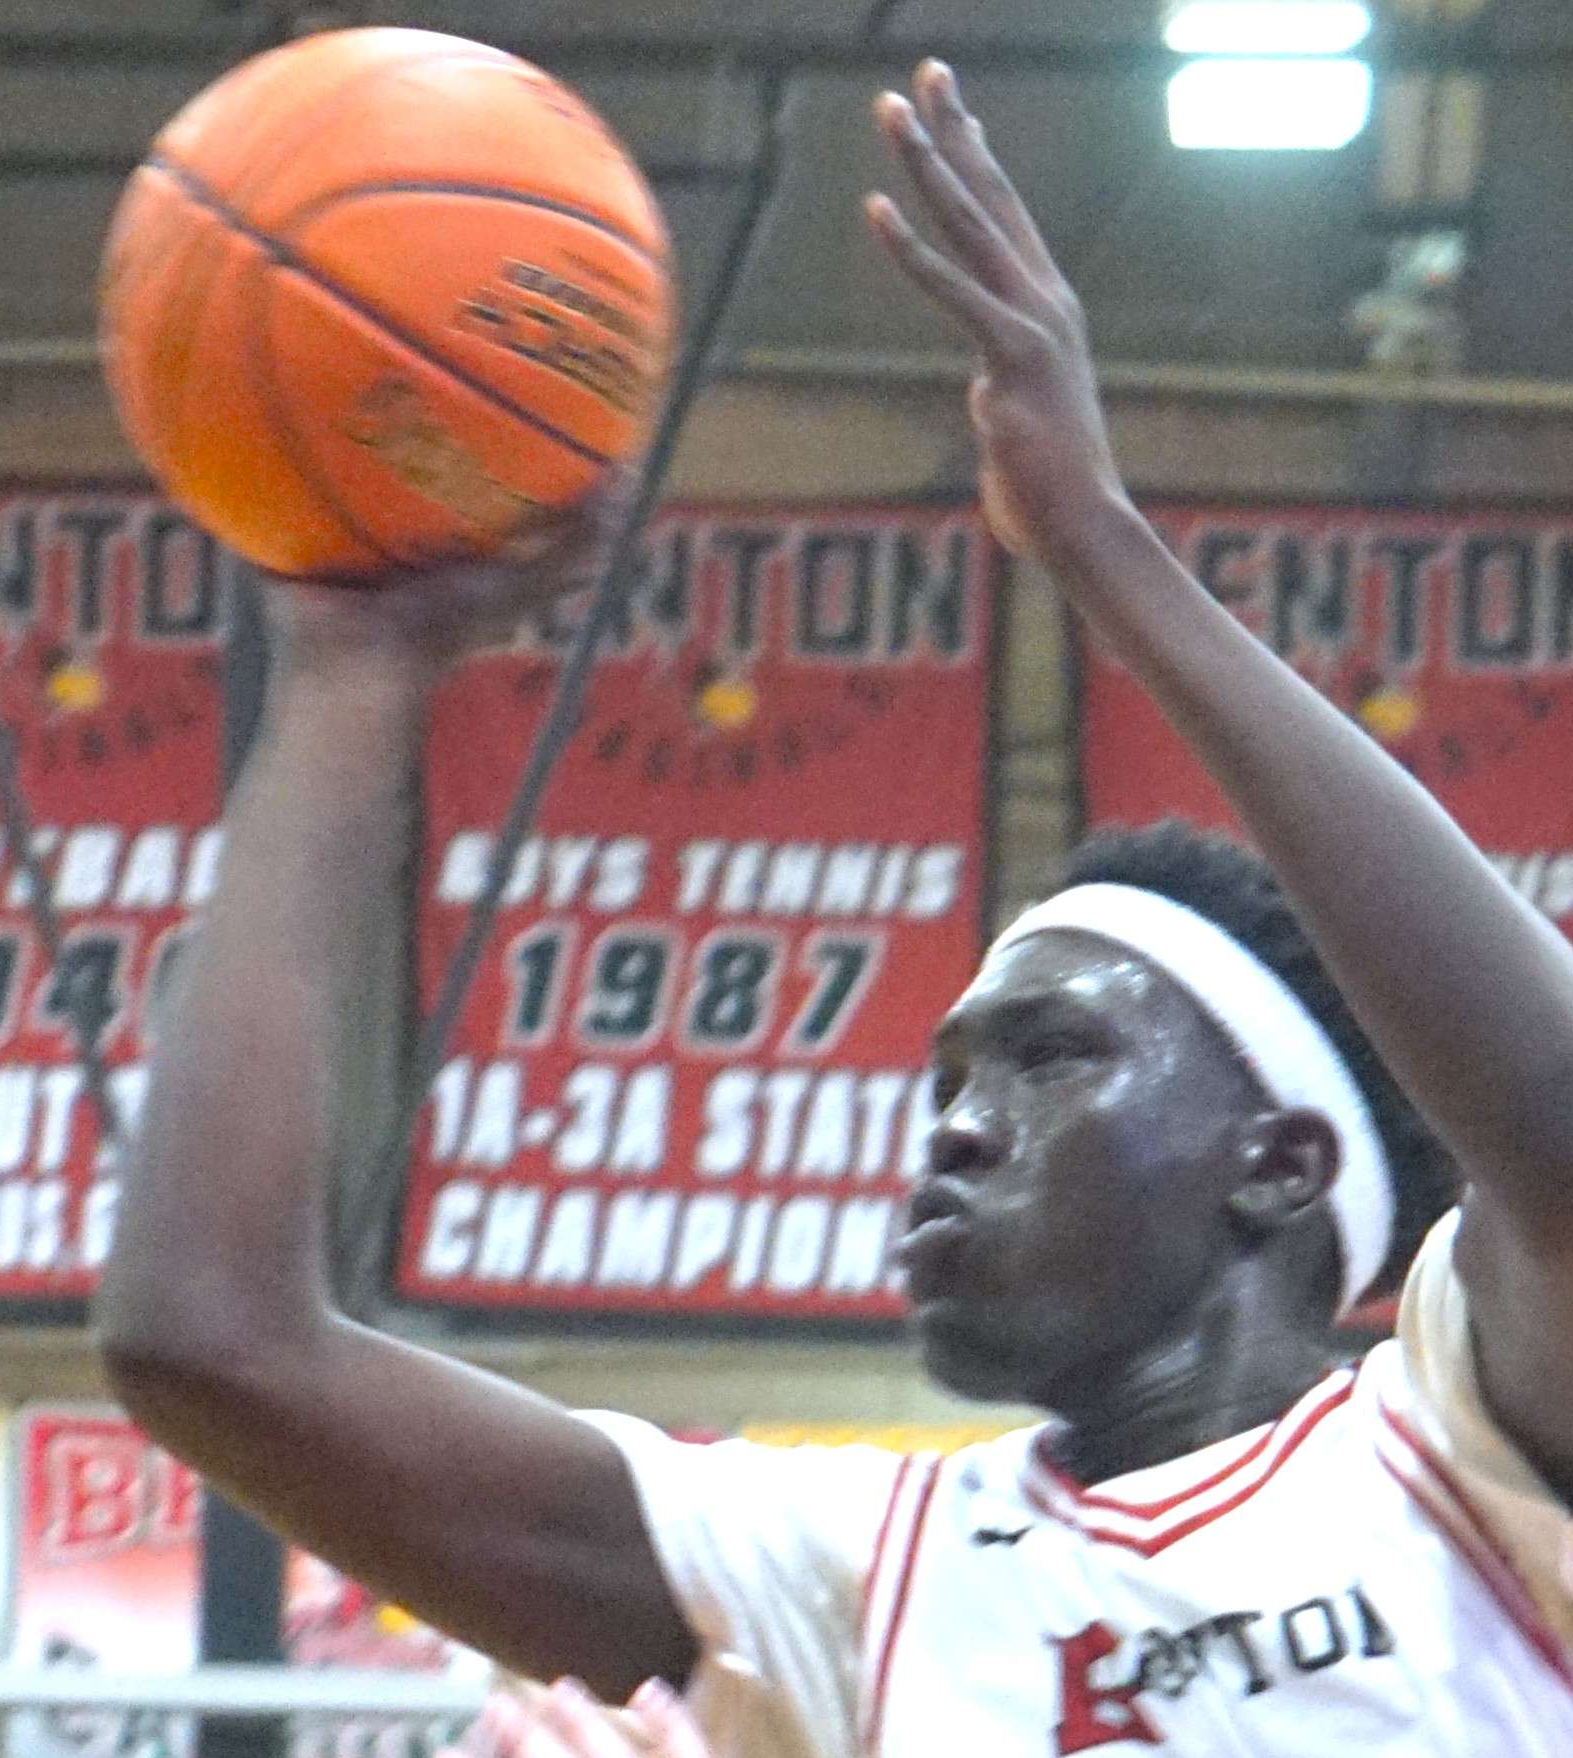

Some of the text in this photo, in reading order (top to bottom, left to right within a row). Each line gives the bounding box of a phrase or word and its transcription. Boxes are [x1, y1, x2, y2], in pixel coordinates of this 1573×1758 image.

[676, 838, 966, 920] TENNIS
[503, 922, 890, 1058] 1987
[430, 1056, 674, 1174] 1A-3A
[417, 1178, 912, 1297] CHAMPION
